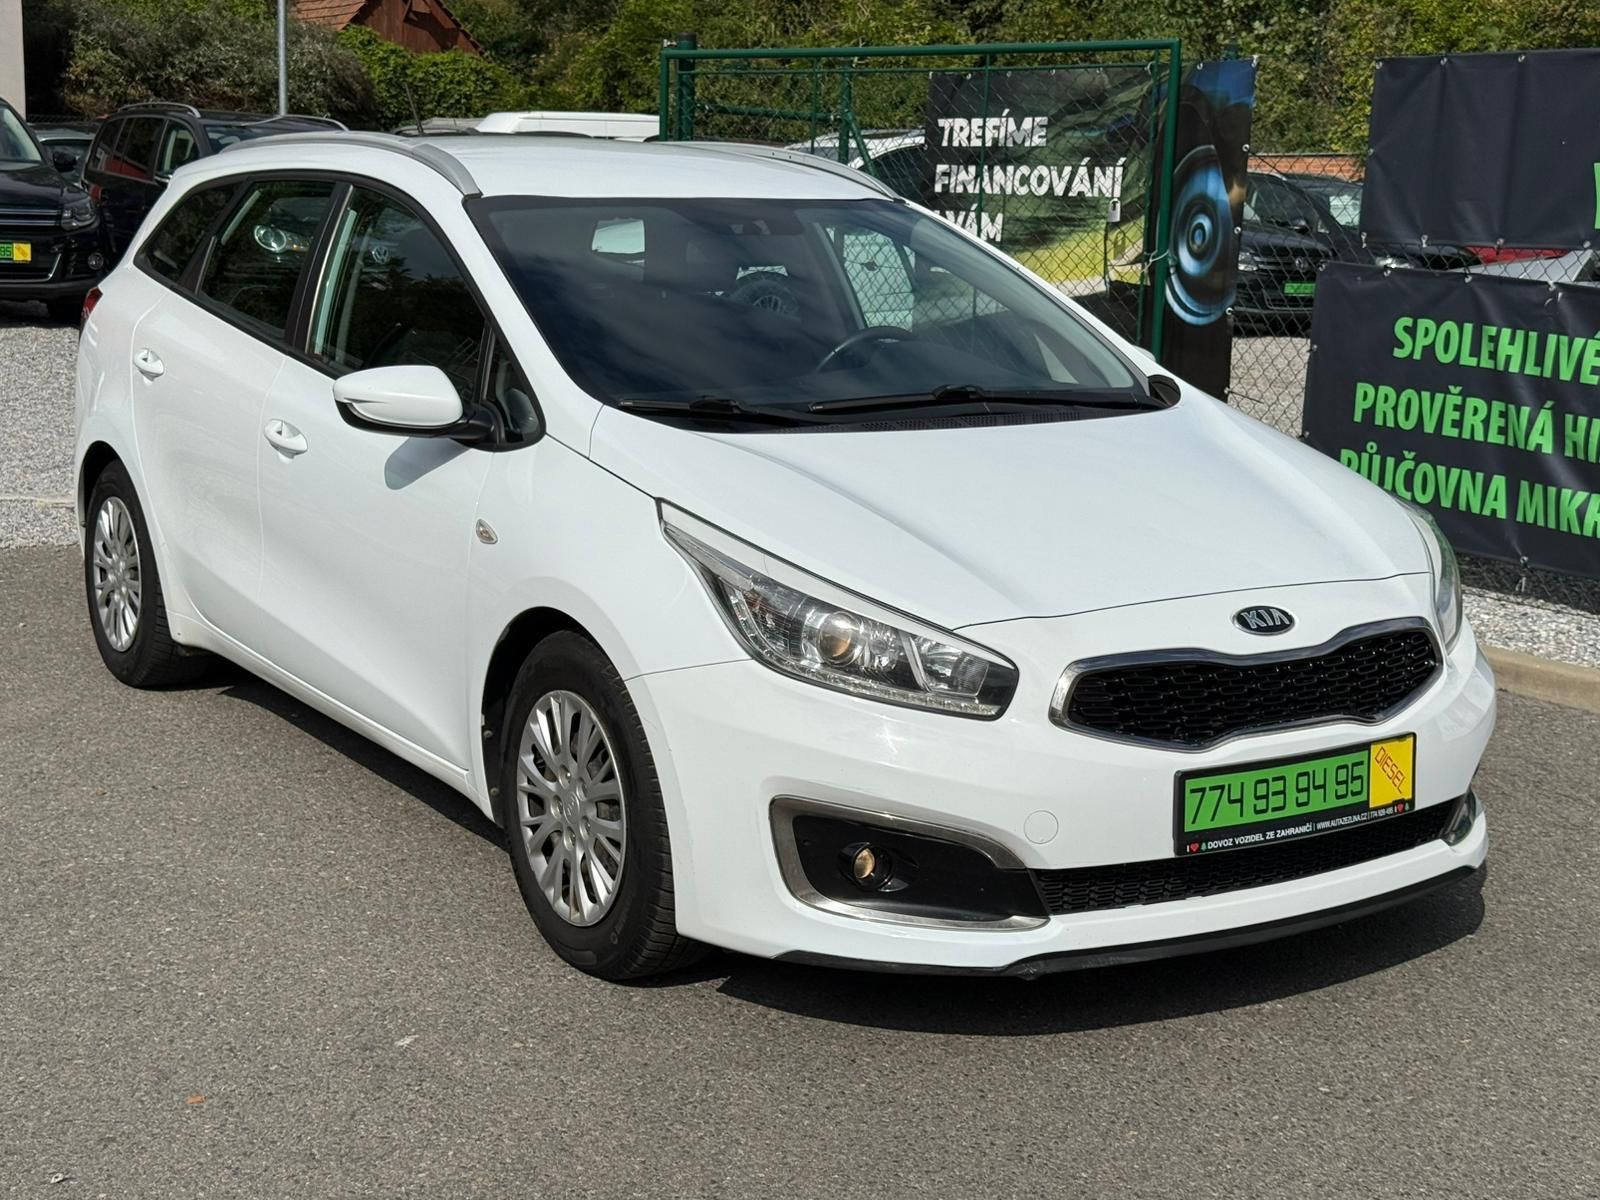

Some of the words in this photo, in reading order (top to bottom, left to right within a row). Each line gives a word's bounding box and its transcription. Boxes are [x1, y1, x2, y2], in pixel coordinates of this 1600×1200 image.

[938, 108, 1048, 147] TREFÍME
[934, 157, 1127, 198] FINANCOVÁNÍ
[1393, 316, 1600, 386] SPOLEHLIVÉ
[1353, 382, 1555, 455] PROVĚRENÁ
[1564, 413, 1600, 464] HI
[1240, 608, 1290, 629] KIA
[1374, 746, 1406, 794] DIESEL
[1189, 781, 1245, 825] 774
[1253, 775, 1287, 815] 93
[1295, 767, 1328, 808] 94
[1334, 760, 1365, 800] 95
[1207, 838, 1233, 849] DOVOZ
[1234, 833, 1265, 845] VOZIDEL
[1266, 829, 1275, 840] ZE
[1276, 821, 1313, 838] ZAHRANIČÍ
